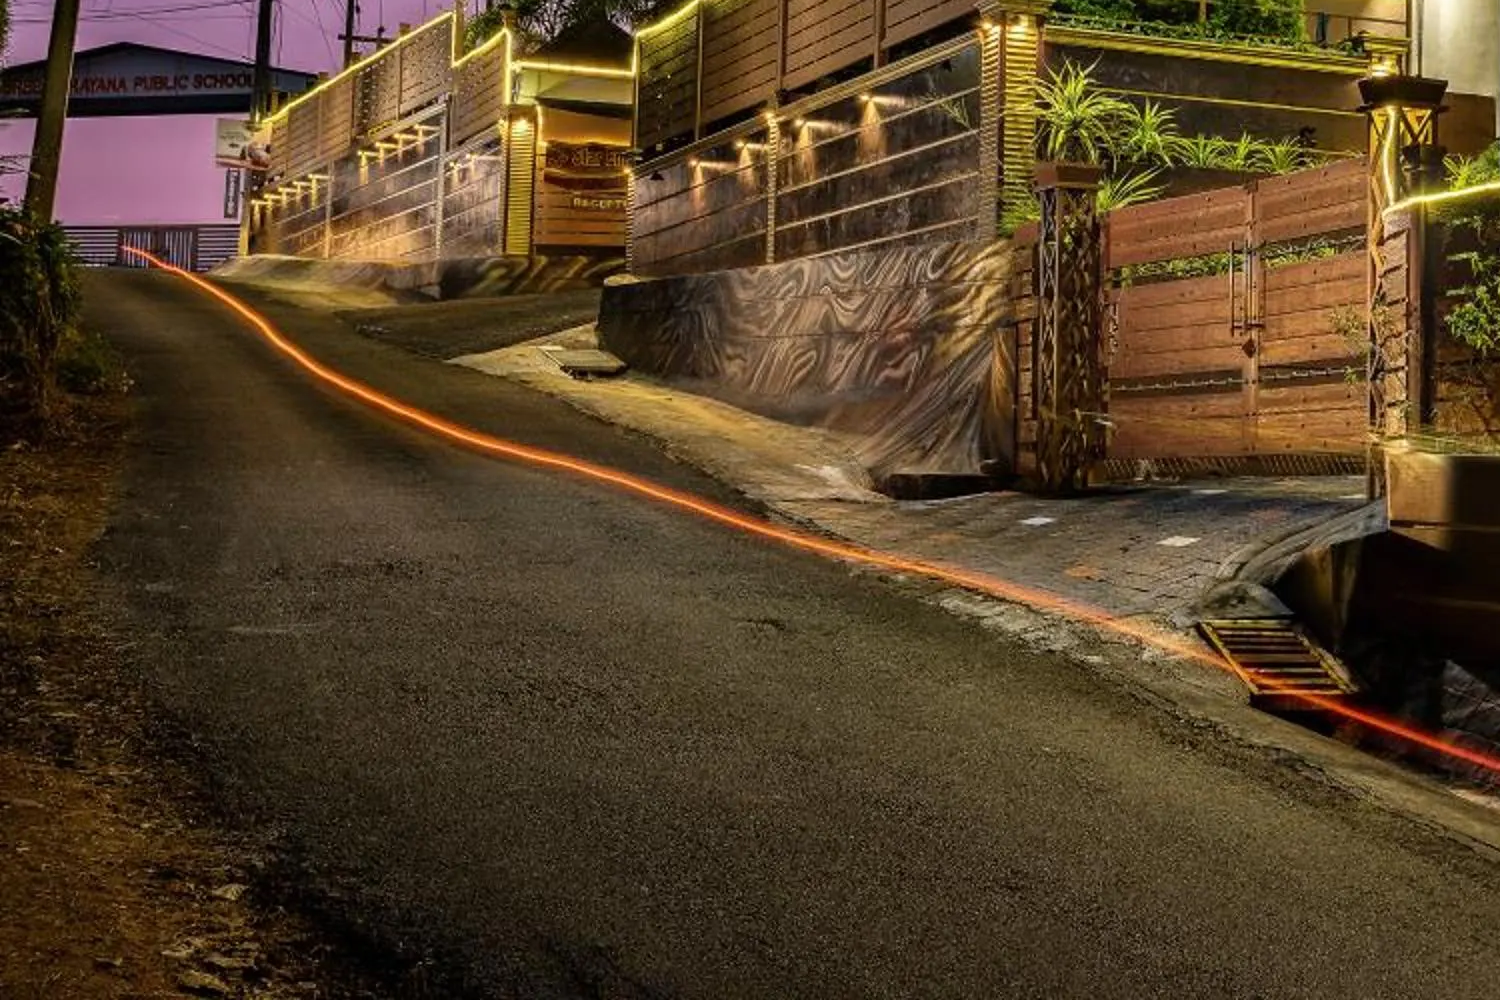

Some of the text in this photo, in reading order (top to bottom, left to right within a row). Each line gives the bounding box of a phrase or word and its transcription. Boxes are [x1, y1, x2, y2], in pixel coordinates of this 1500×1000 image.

[70, 72, 257, 94] RAYANA PUBLIC SCHOOL
